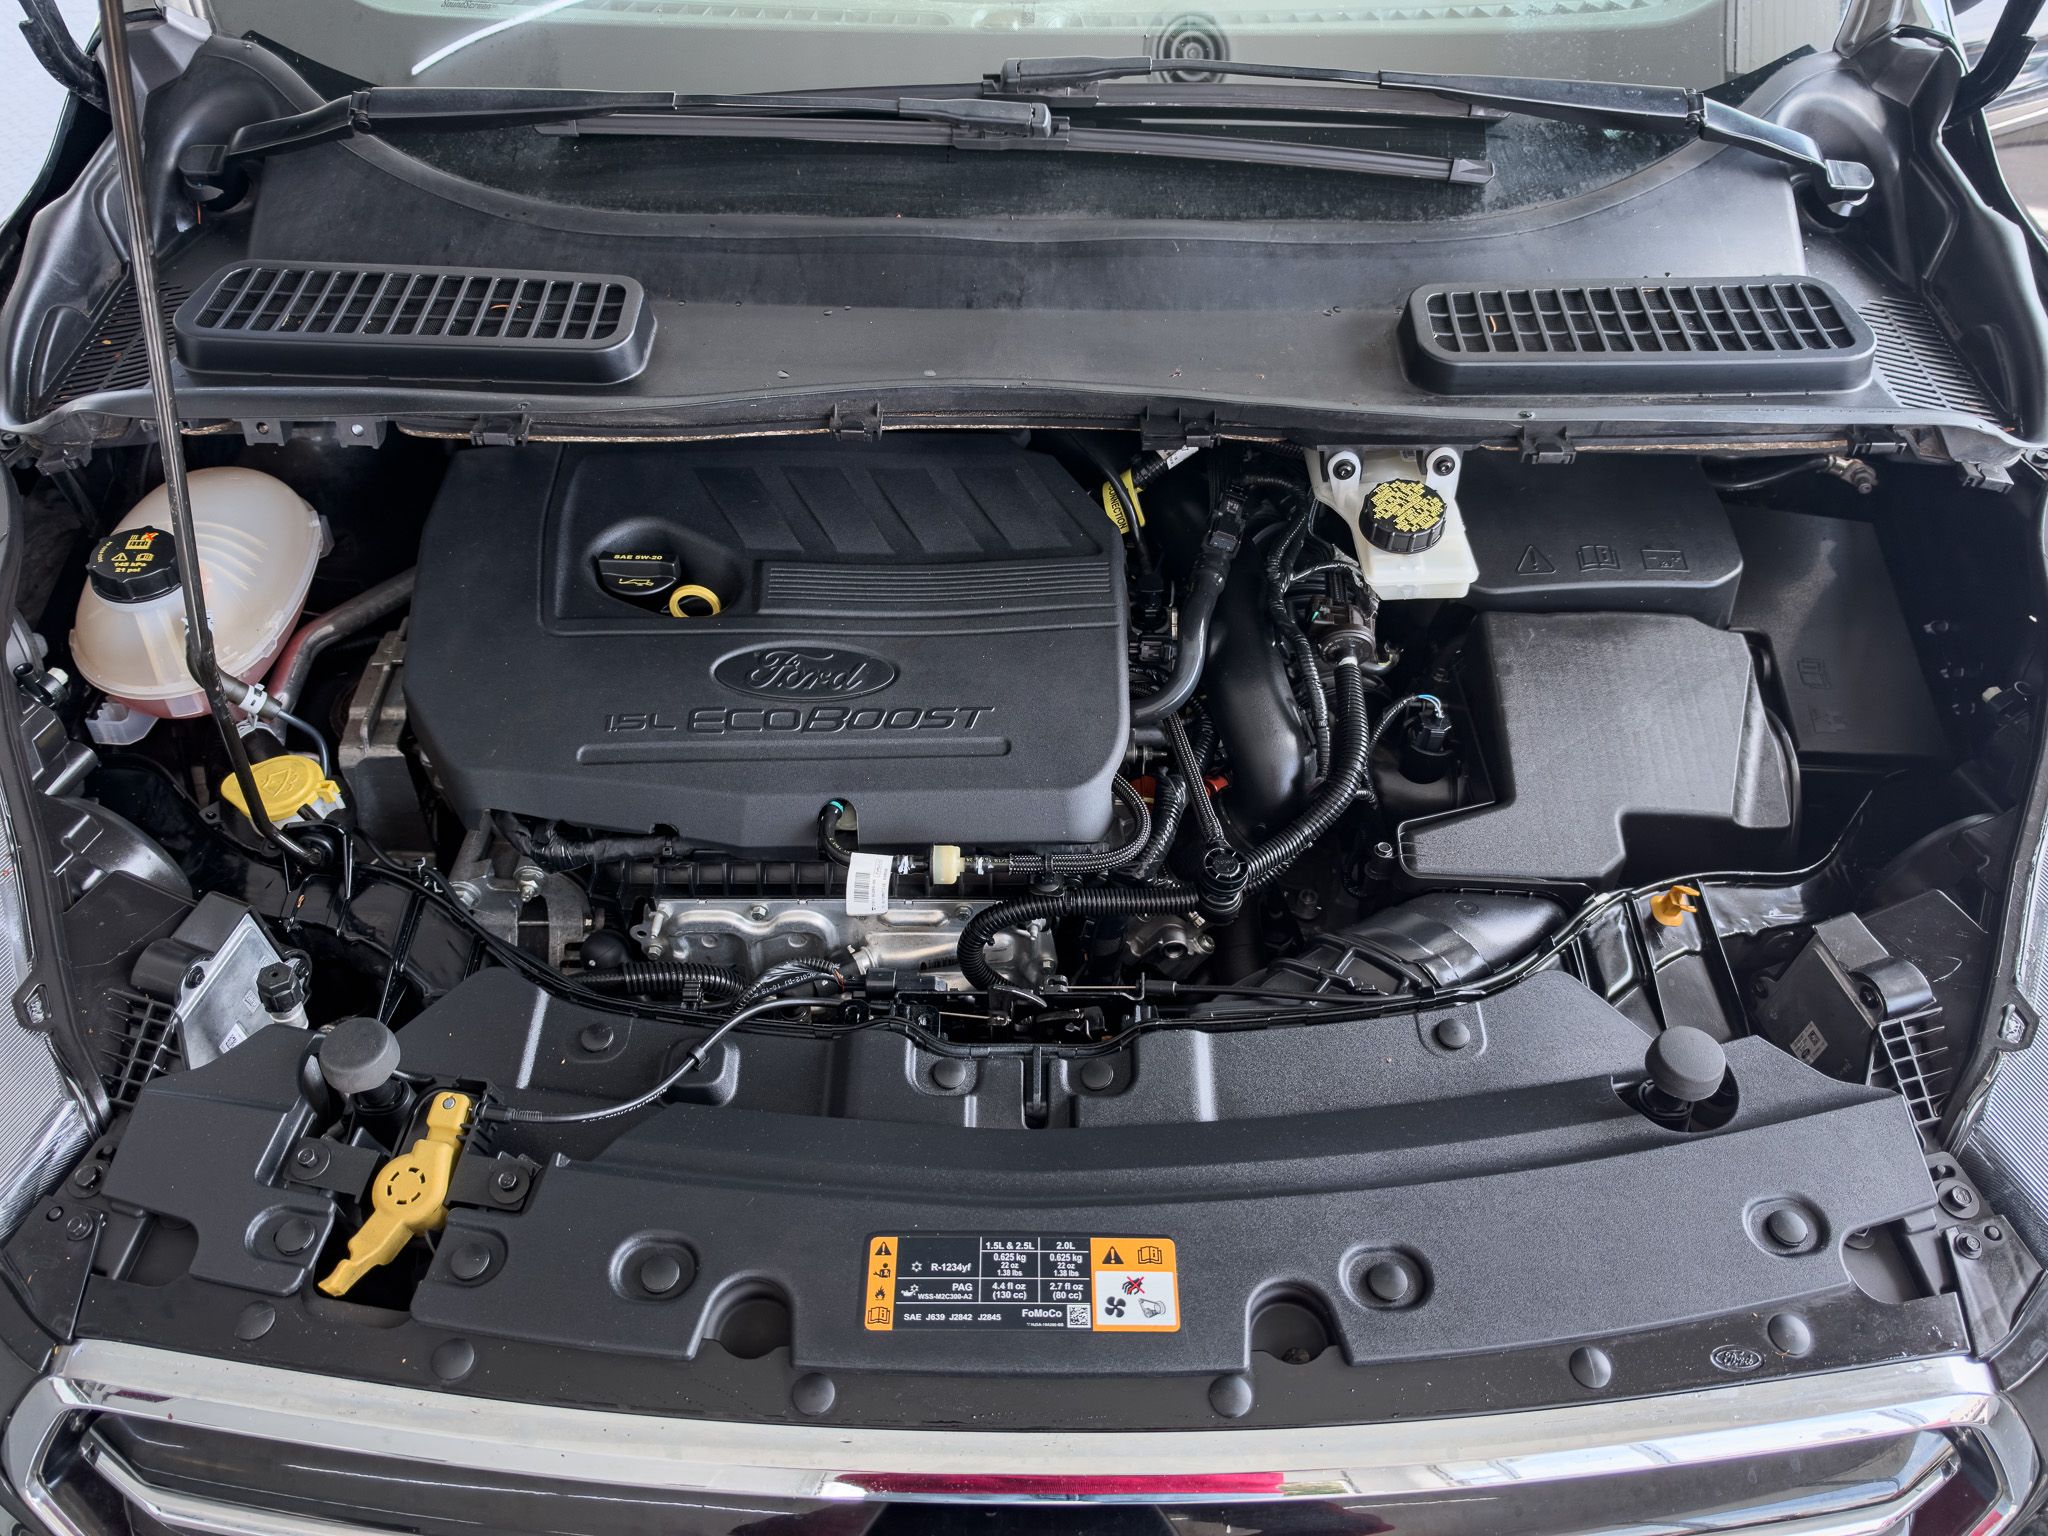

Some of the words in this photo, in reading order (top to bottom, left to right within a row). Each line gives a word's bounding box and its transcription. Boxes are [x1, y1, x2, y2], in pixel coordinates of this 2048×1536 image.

[746, 650, 867, 691] Ford
[986, 1242, 1004, 1250] 1.5L
[1006, 1242, 1013, 1250] &
[1016, 1242, 1035, 1250] 2.5L
[993, 1253, 1015, 1261] 0.625
[1016, 1253, 1026, 1263] kg
[1072, 1254, 1082, 1263] kg
[931, 1263, 972, 1273] R-1234yf
[952, 1283, 973, 1291] PAG
[992, 1291, 1011, 1300] (130
[1013, 1291, 1027, 1300] cc)
[1053, 1292, 1066, 1300] (80
[1068, 1292, 1082, 1300] cc)
[1022, 1309, 1062, 1317] FoMoCo
